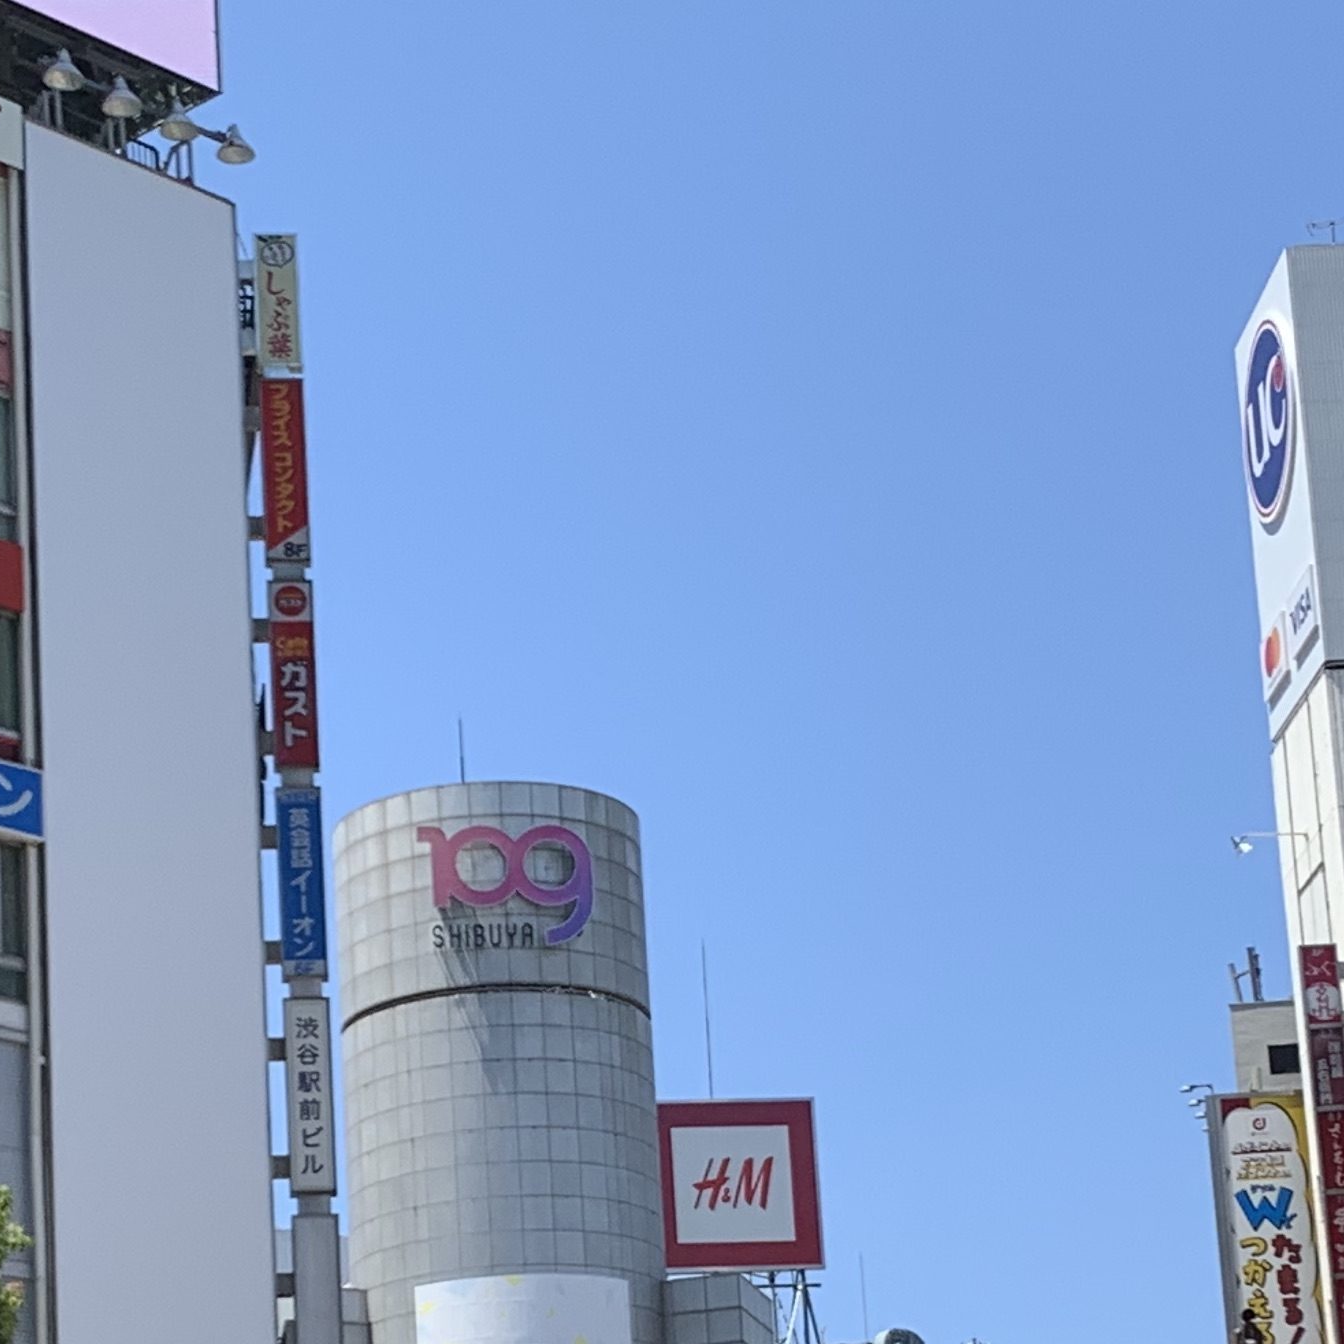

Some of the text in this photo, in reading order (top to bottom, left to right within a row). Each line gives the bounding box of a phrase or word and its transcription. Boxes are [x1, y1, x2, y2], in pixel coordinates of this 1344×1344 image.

[265, 270, 293, 359] しゃぶ葉
[267, 383, 297, 533] プライス コンタクト
[1246, 354, 1286, 478] UC
[282, 540, 308, 557] 8F
[1289, 586, 1312, 636] VISA
[280, 660, 310, 748] ガスト
[287, 807, 316, 958] 英会話イーオン
[416, 824, 595, 946] 109
[431, 923, 535, 950] SHIBUYA
[295, 1016, 325, 1176] 渋谷駅前ビル
[692, 1155, 774, 1211] H&M
